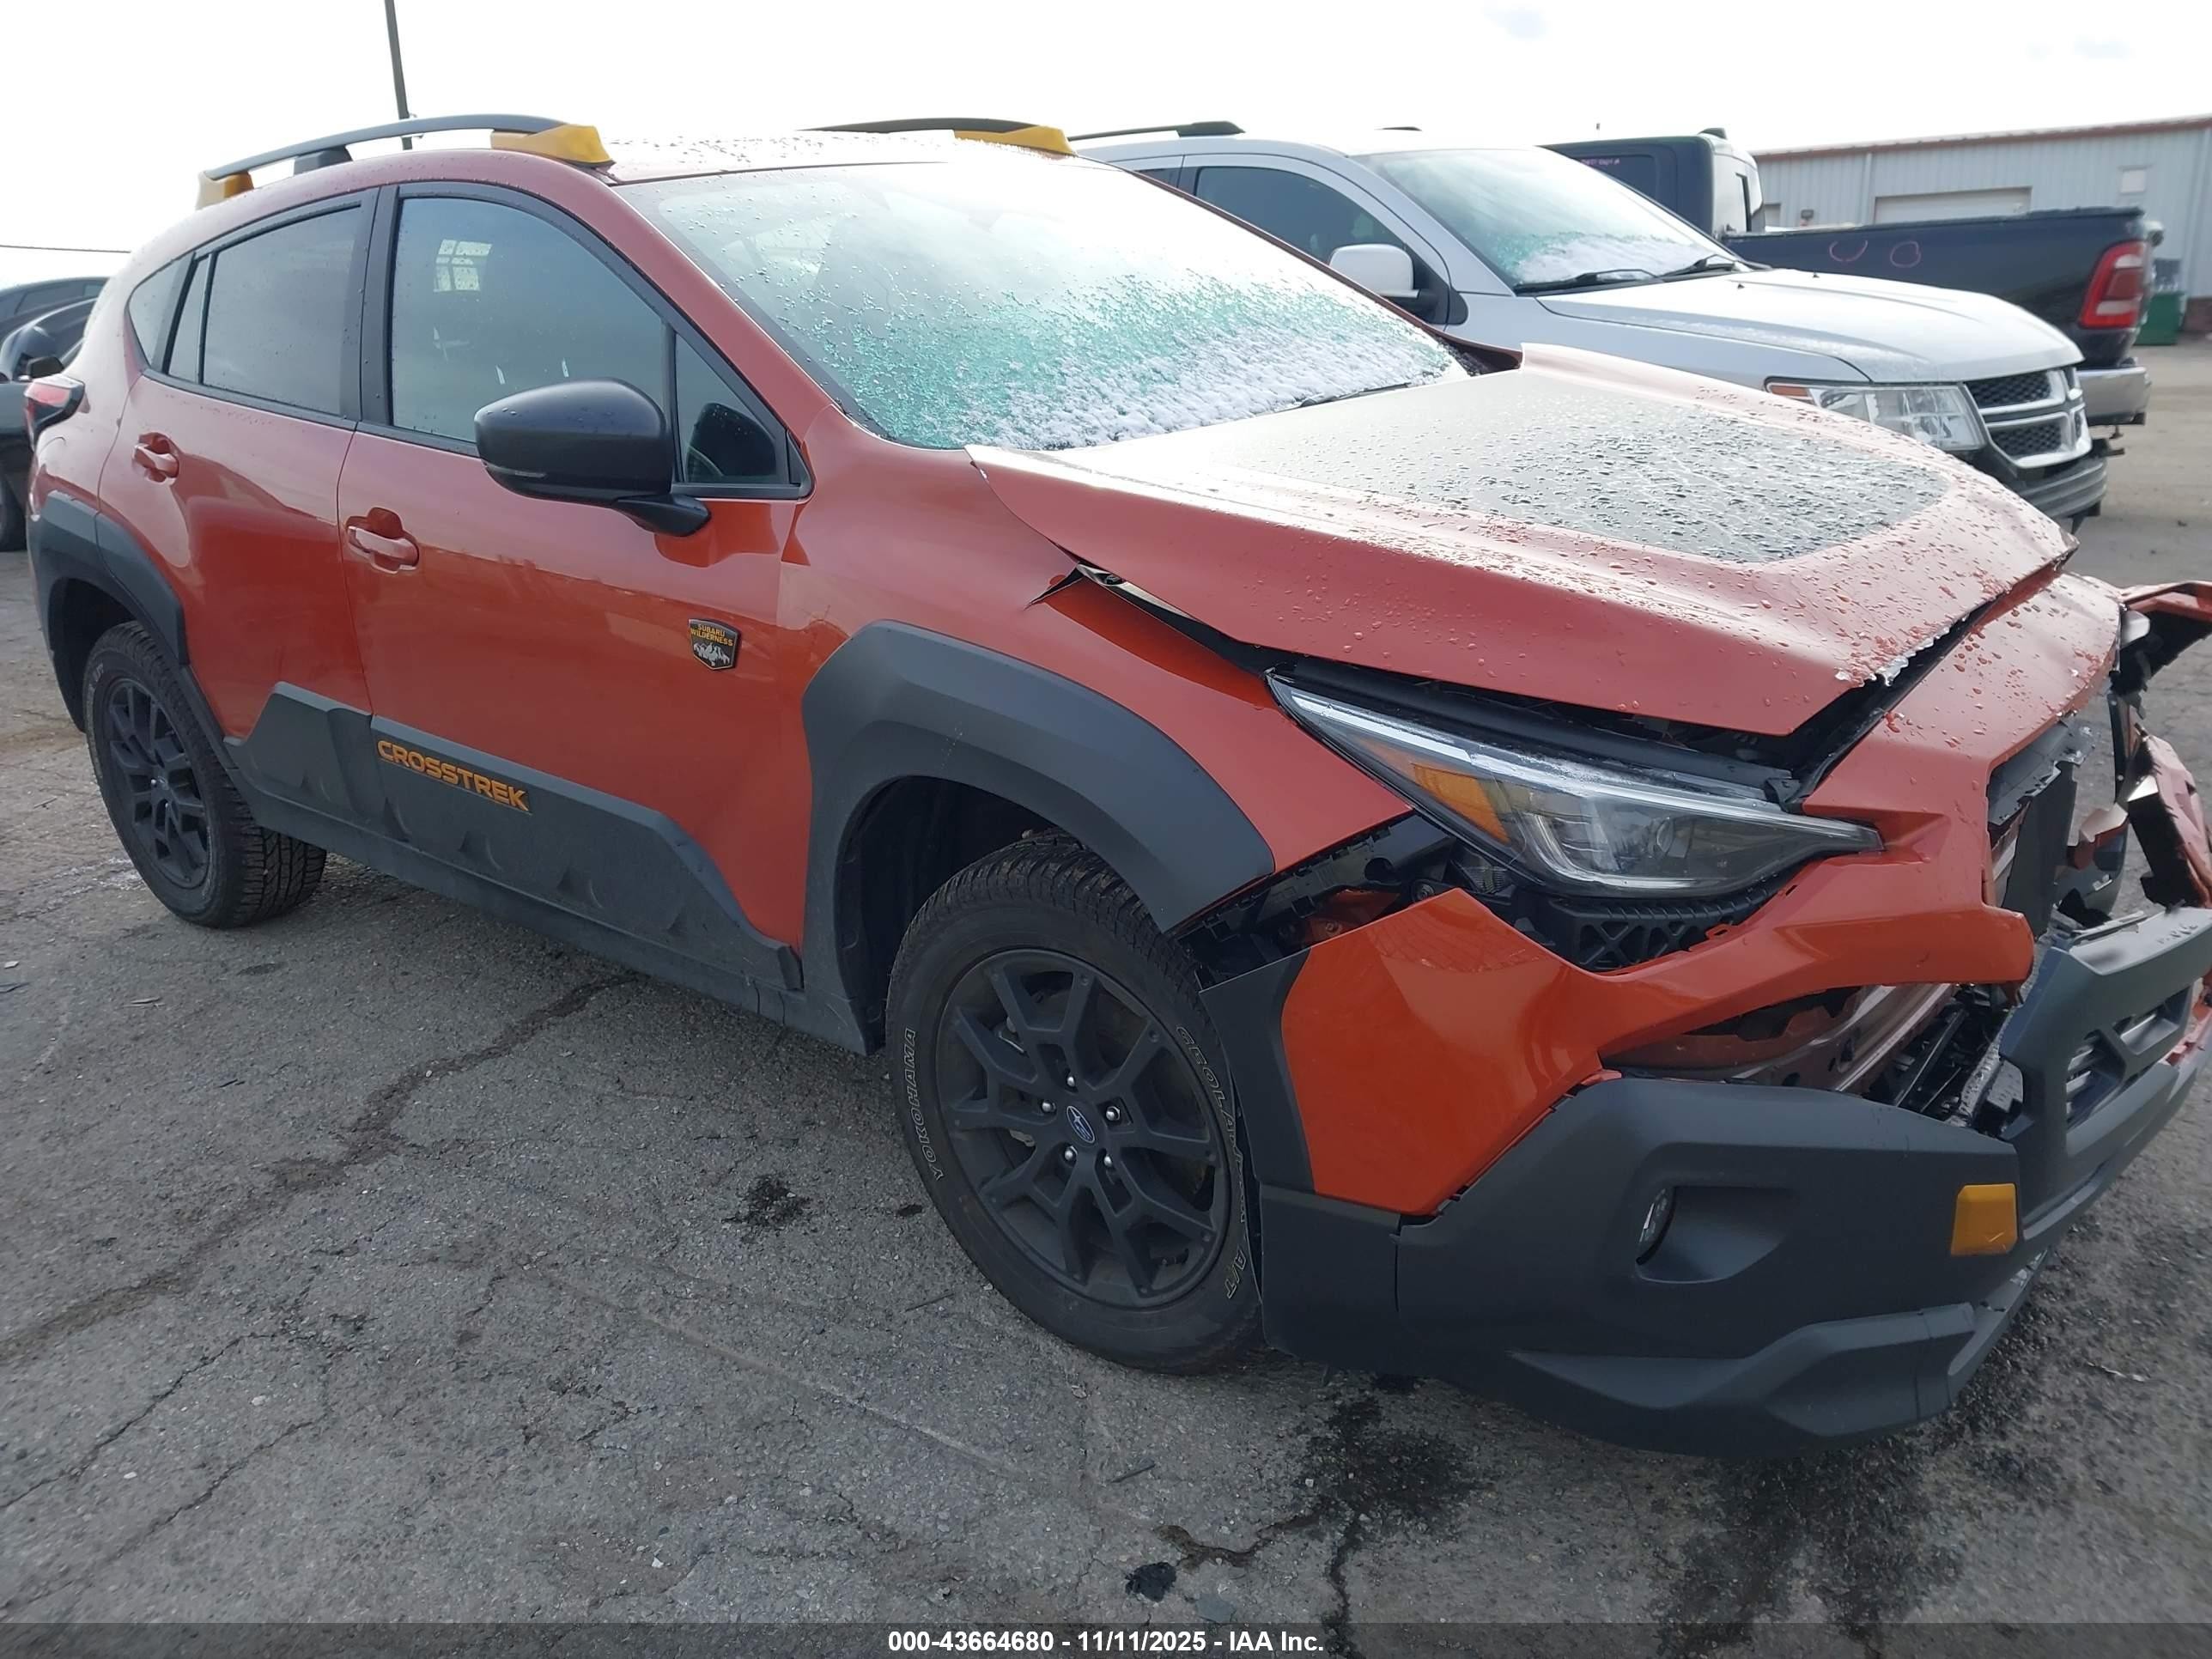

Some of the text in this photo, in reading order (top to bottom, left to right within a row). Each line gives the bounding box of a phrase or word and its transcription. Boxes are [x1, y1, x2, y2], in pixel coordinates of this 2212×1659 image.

[690, 628, 733, 647] WILDERNESS
[698, 623, 726, 637] SUBARU
[377, 740, 529, 811] CROSSTREK
[904, 1028, 944, 1181] YOKOHAMA
[1224, 1249, 1247, 1298] A/T
